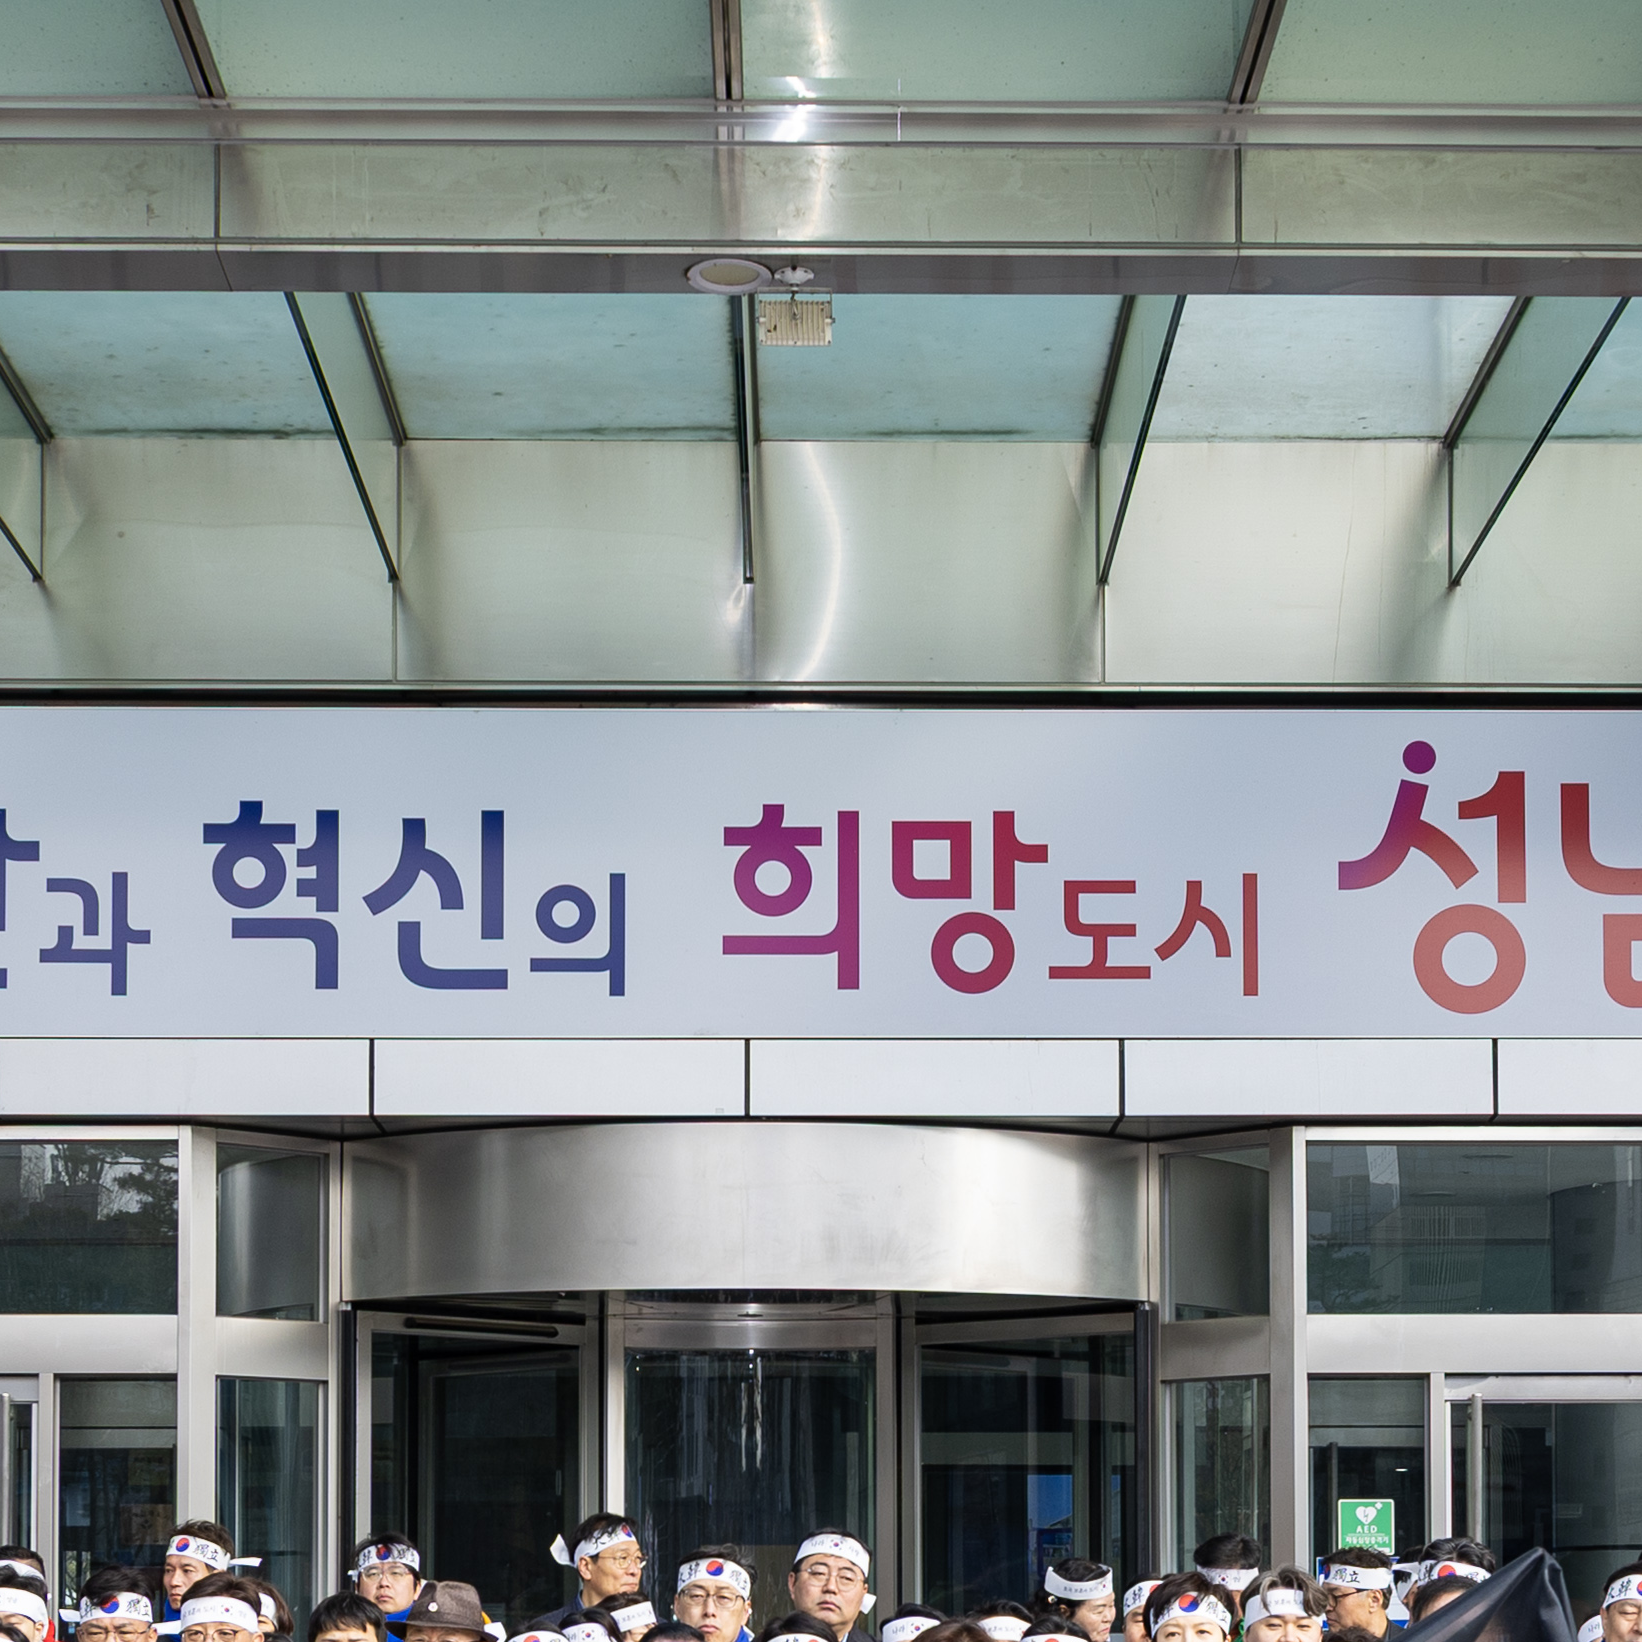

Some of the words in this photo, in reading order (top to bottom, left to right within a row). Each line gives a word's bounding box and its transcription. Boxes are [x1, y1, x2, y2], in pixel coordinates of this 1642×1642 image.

[201, 800, 626, 996] 혁신의
[721, 803, 1259, 996] 희망도시
[1355, 1525, 1378, 1534] AED
[193, 1542, 219, 1563] 獨立
[1333, 1567, 1362, 1585] 獨立
